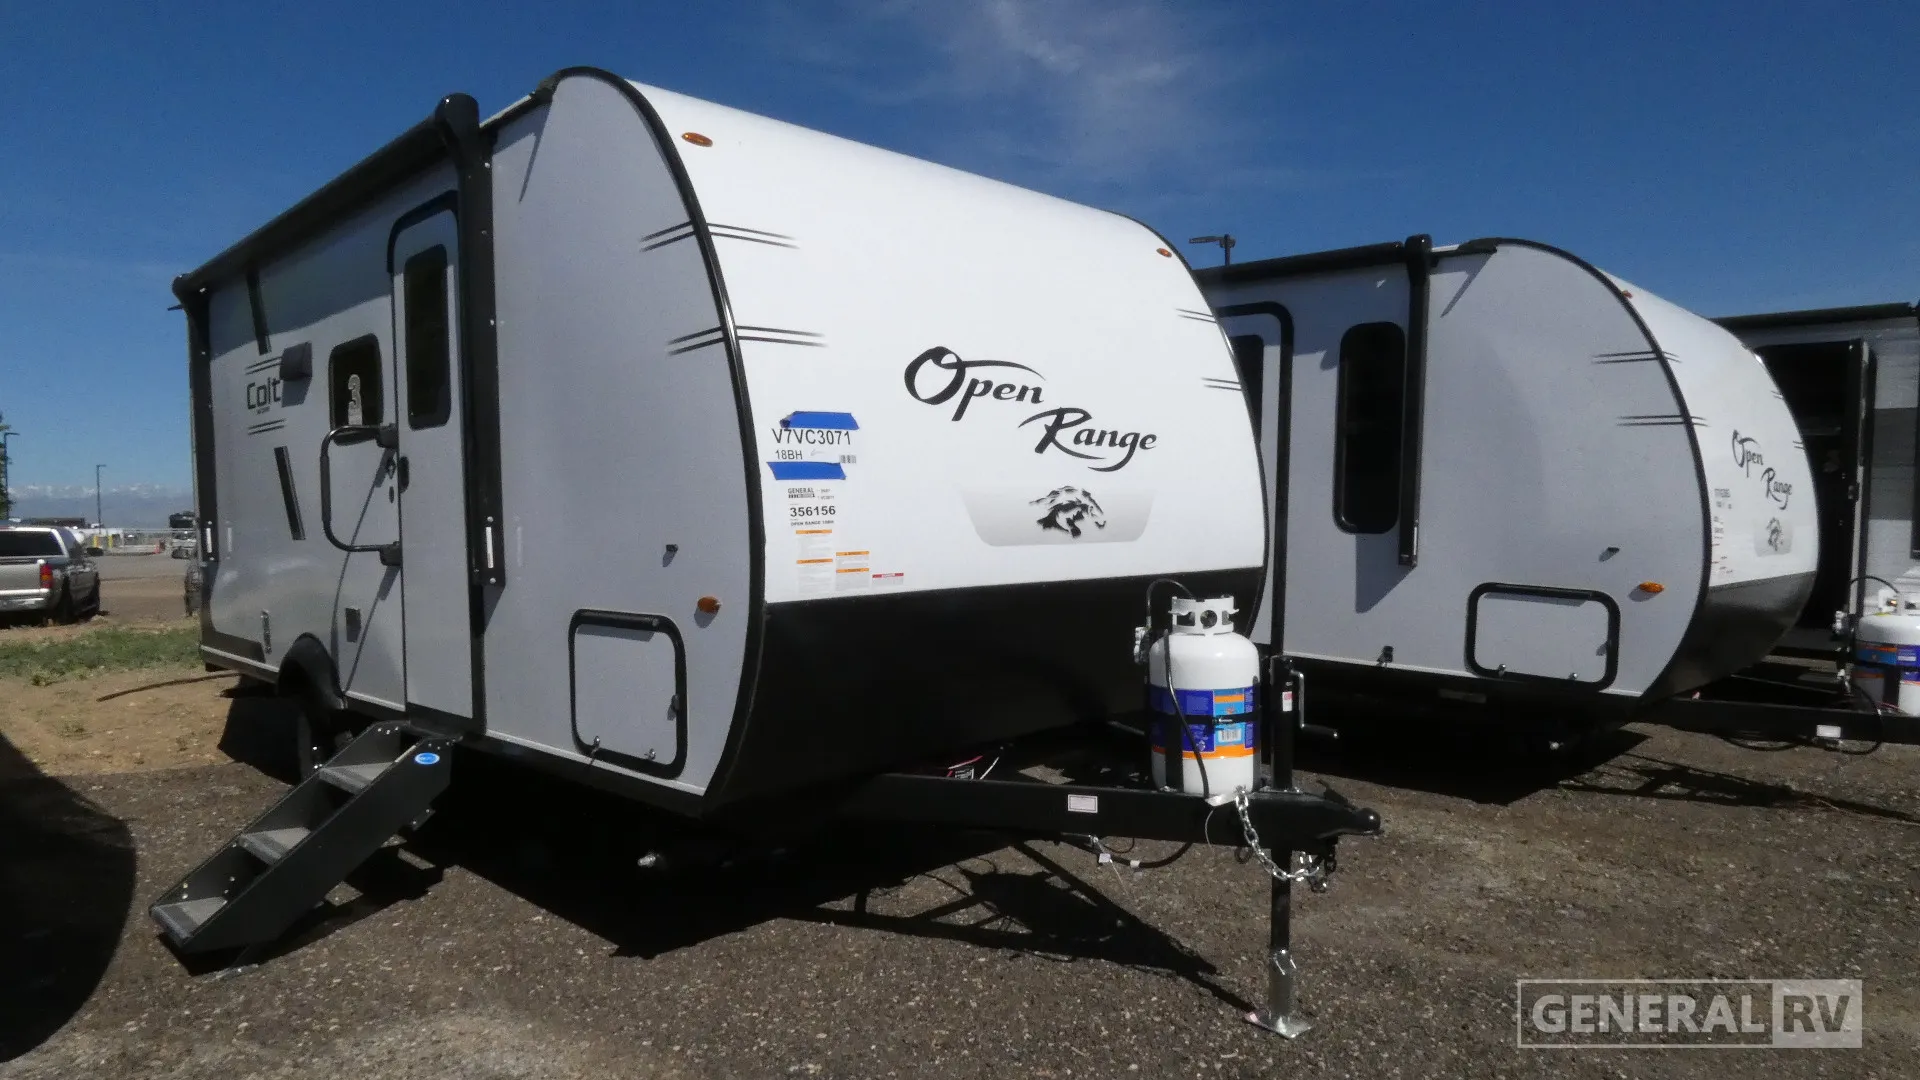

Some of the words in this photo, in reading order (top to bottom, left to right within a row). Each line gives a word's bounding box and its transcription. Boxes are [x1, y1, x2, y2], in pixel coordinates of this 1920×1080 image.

[247, 377, 281, 409] Colt
[904, 346, 1046, 421] Open
[772, 428, 851, 445] V7VC3071
[775, 449, 803, 460] 18BH
[1018, 407, 1157, 472] Range
[1732, 430, 1763, 478] Open
[1760, 467, 1792, 510] Range
[790, 506, 836, 517] 356156
